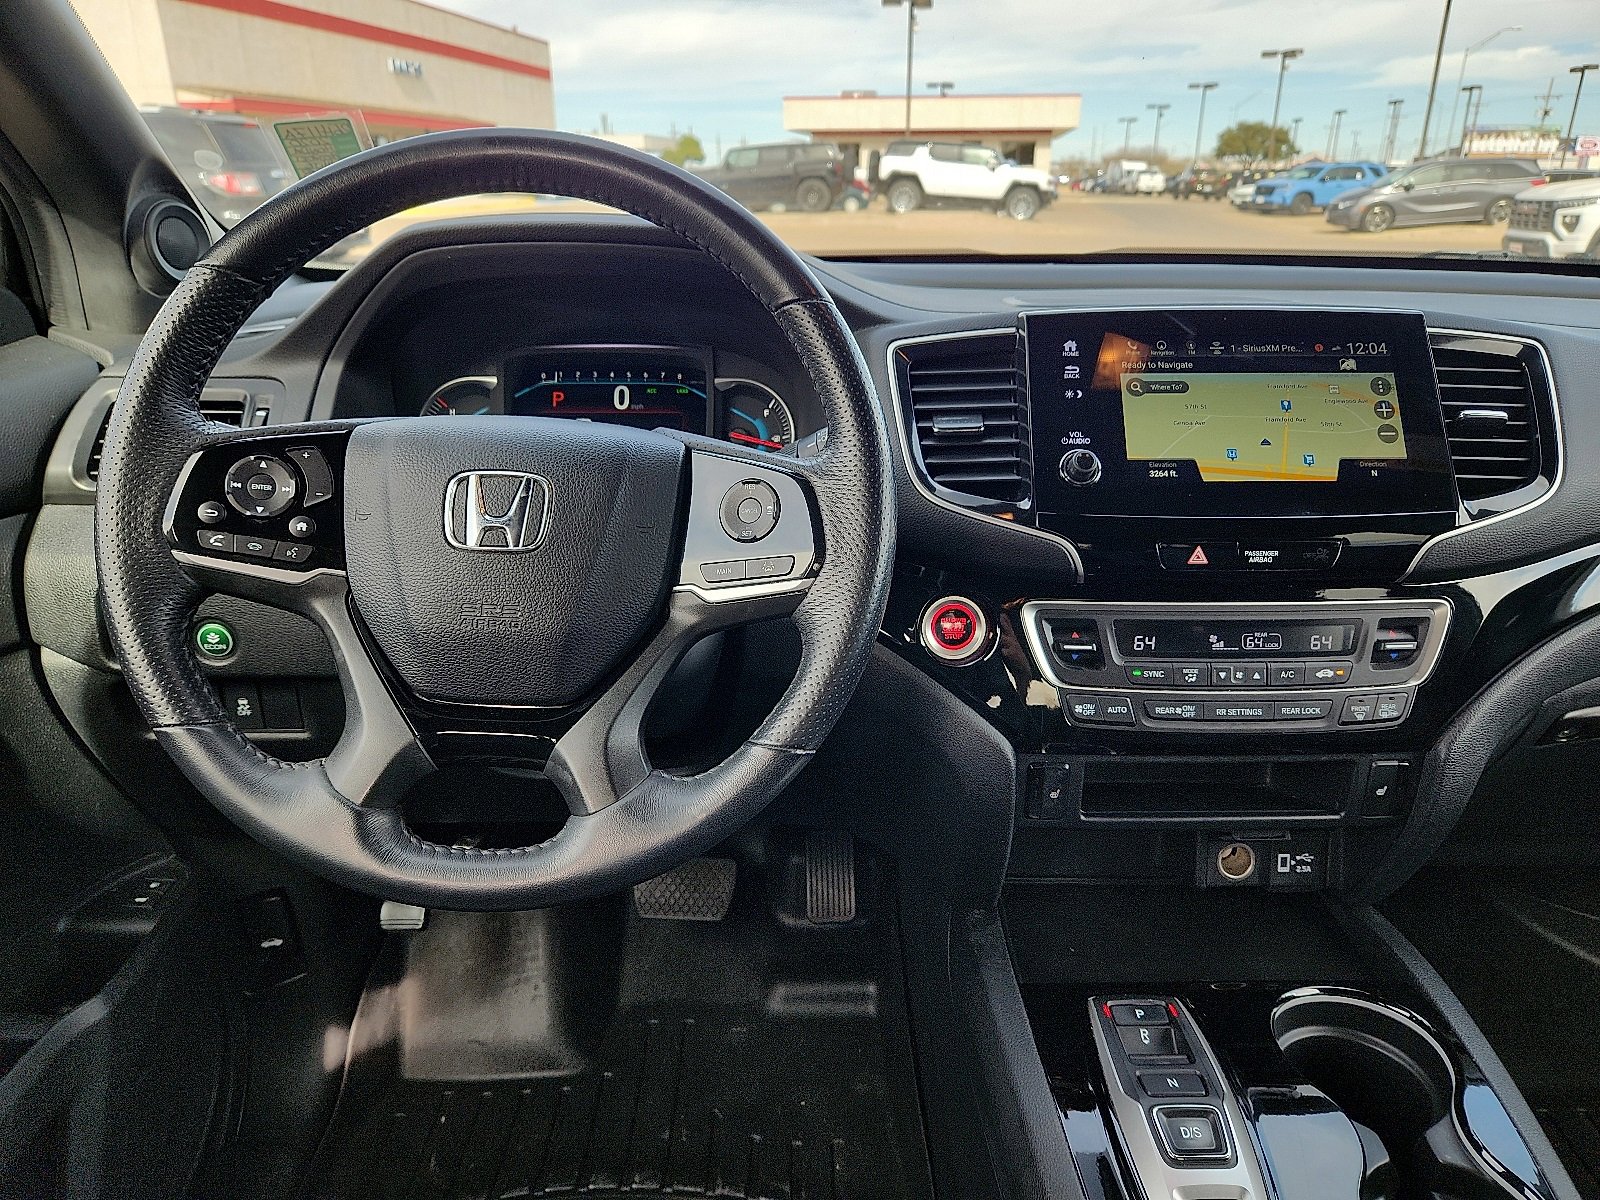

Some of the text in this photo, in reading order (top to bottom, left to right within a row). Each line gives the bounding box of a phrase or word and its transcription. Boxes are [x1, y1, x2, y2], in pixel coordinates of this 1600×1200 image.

[1242, 344, 1280, 352] SiriusXM
[1347, 342, 1388, 355] 12:04
[1121, 361, 1194, 370] Ready to Navigate
[552, 391, 565, 407] P
[613, 385, 630, 410] 0
[1149, 470, 1179, 478] 3264 ft.
[1371, 469, 1378, 477] N
[716, 567, 732, 575] MAIN
[1133, 635, 1156, 651] 64
[1246, 637, 1263, 648] 64
[1310, 635, 1333, 650] 64
[1143, 670, 1165, 678] SYNC
[1280, 670, 1295, 679] A/C
[1107, 706, 1128, 714] AUTO
[1155, 706, 1175, 715] REAR
[1216, 708, 1263, 716] RR SETTINGS
[1281, 707, 1321, 715] REAR LOCK
[1295, 865, 1312, 873] 2.5A
[1135, 1008, 1145, 1019] P
[1139, 1028, 1150, 1040] R
[1166, 1077, 1180, 1088] N
[1180, 1126, 1203, 1139] D/S
